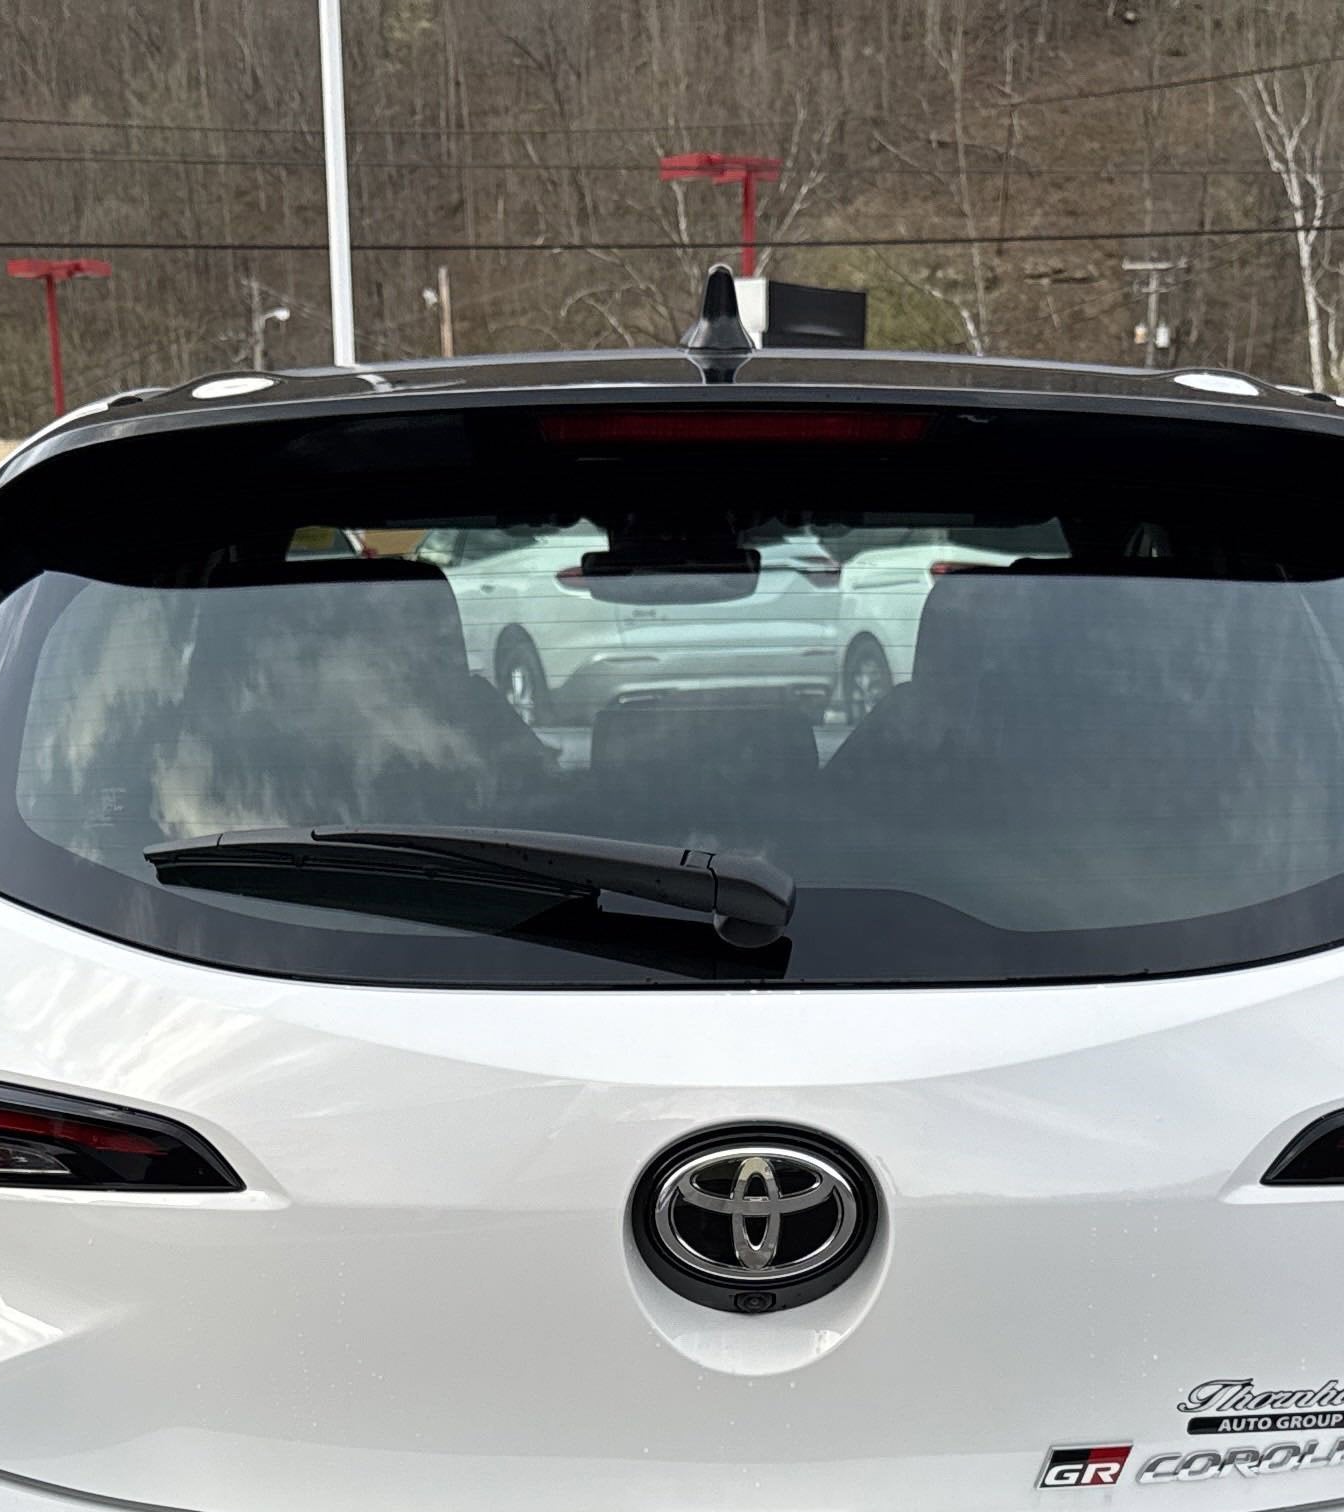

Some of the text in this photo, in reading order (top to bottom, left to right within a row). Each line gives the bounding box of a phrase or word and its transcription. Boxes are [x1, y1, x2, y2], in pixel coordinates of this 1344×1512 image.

[1217, 1413, 1344, 1432] AUTO GROUP
[1044, 1462, 1121, 1486] GR
